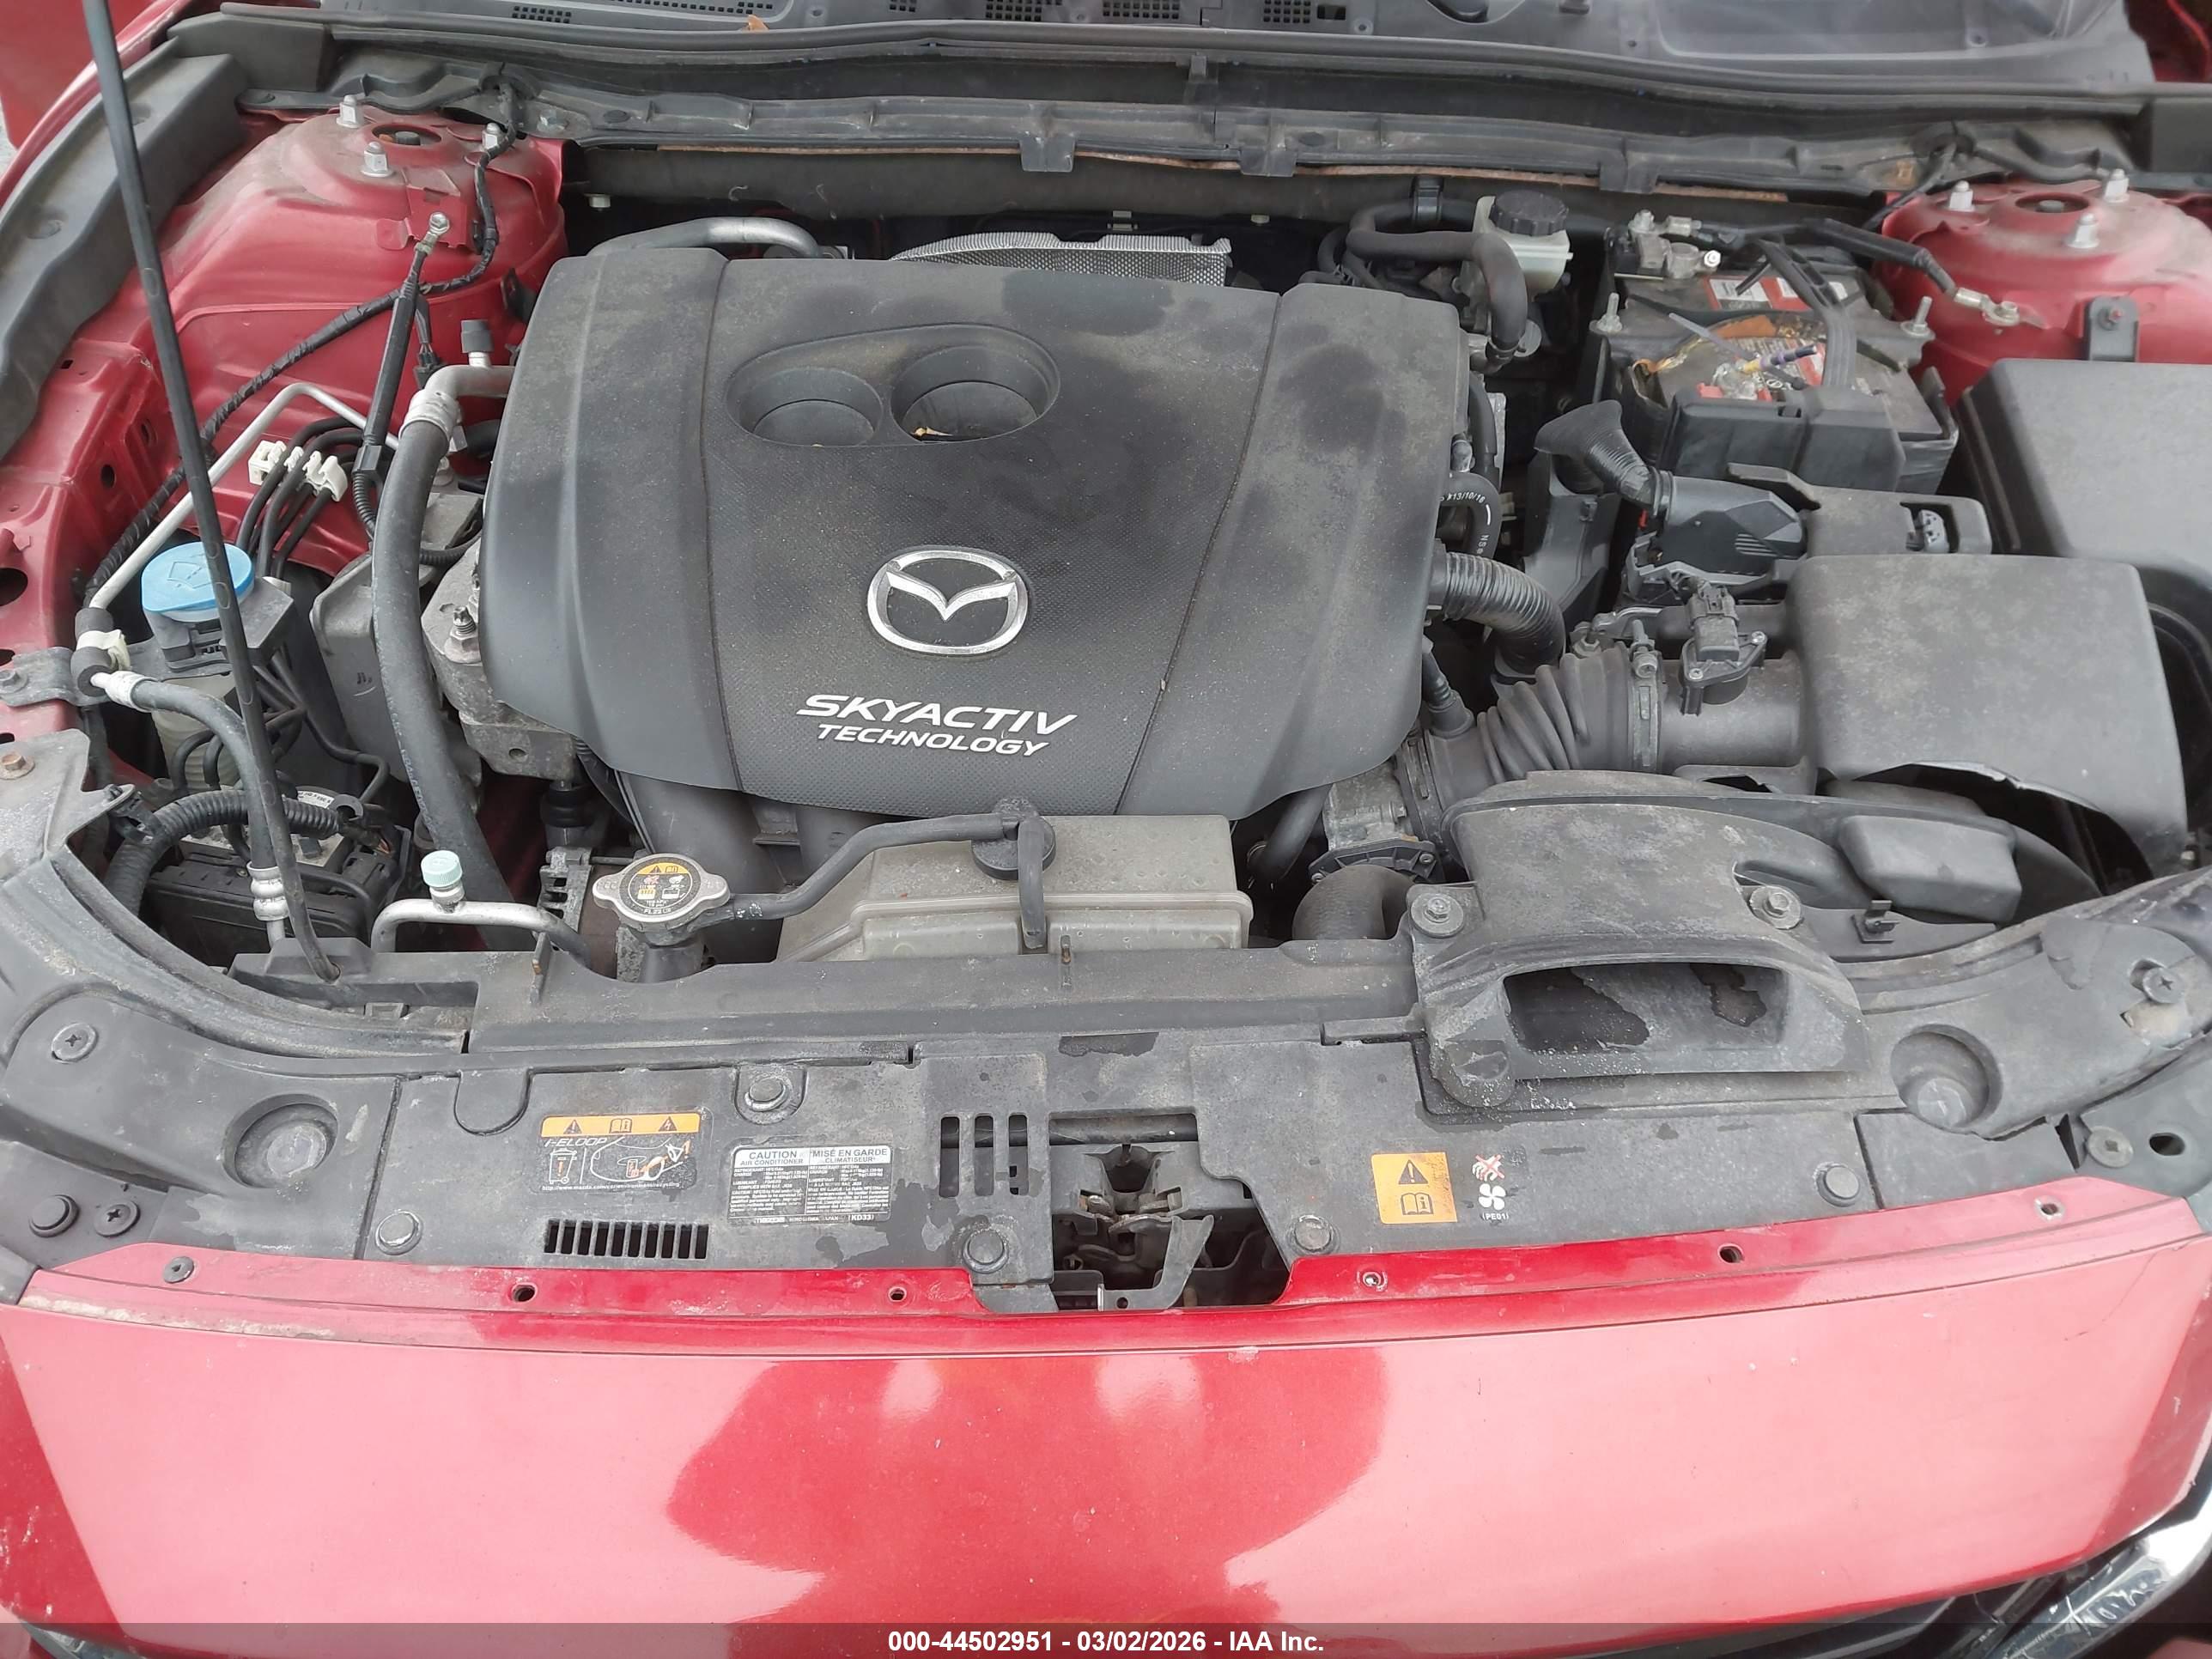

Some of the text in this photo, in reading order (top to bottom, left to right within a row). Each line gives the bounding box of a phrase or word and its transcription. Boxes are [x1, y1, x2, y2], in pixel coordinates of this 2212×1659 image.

[796, 694, 1078, 735] SKYACTIV
[817, 724, 1049, 757] TECHNOLOGY
[749, 1151, 797, 1160] CAUTION
[854, 1148, 887, 1157] GARDE
